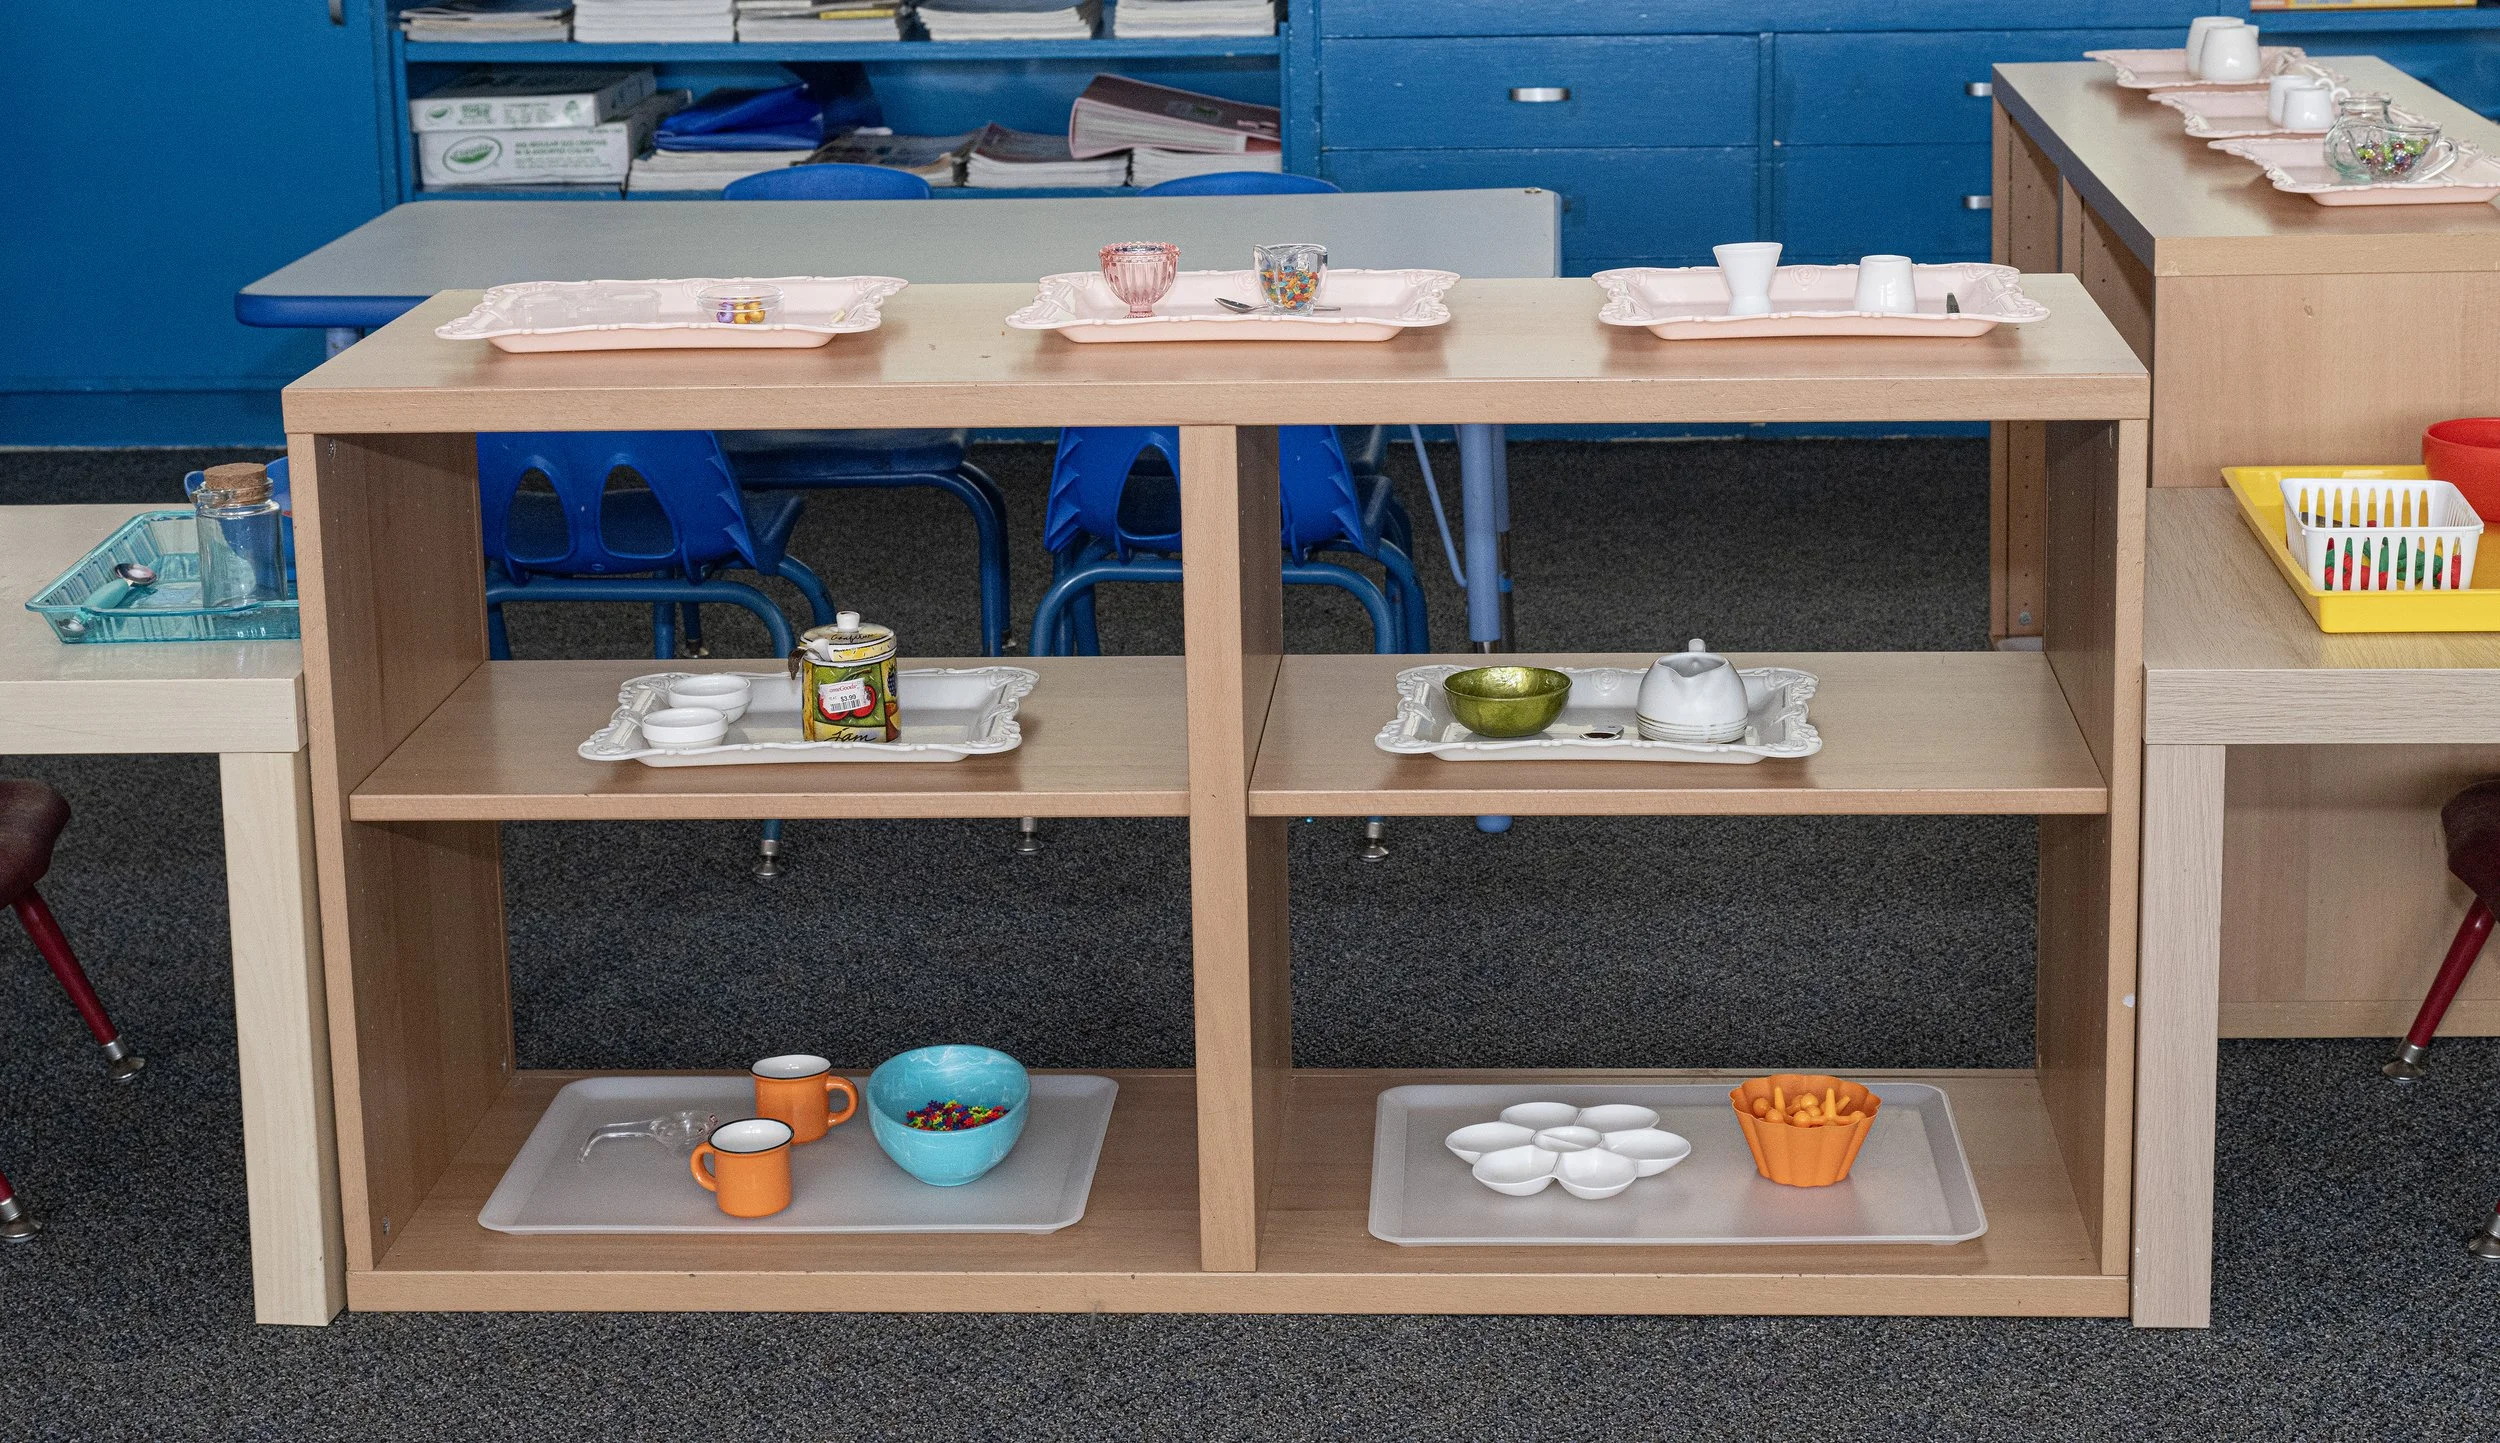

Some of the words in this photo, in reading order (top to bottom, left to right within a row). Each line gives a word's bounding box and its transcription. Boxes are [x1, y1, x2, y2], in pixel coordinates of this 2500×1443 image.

[828, 683, 857, 693] omeGoods
[840, 694, 857, 703] $3.99
[824, 727, 877, 742] Jam
